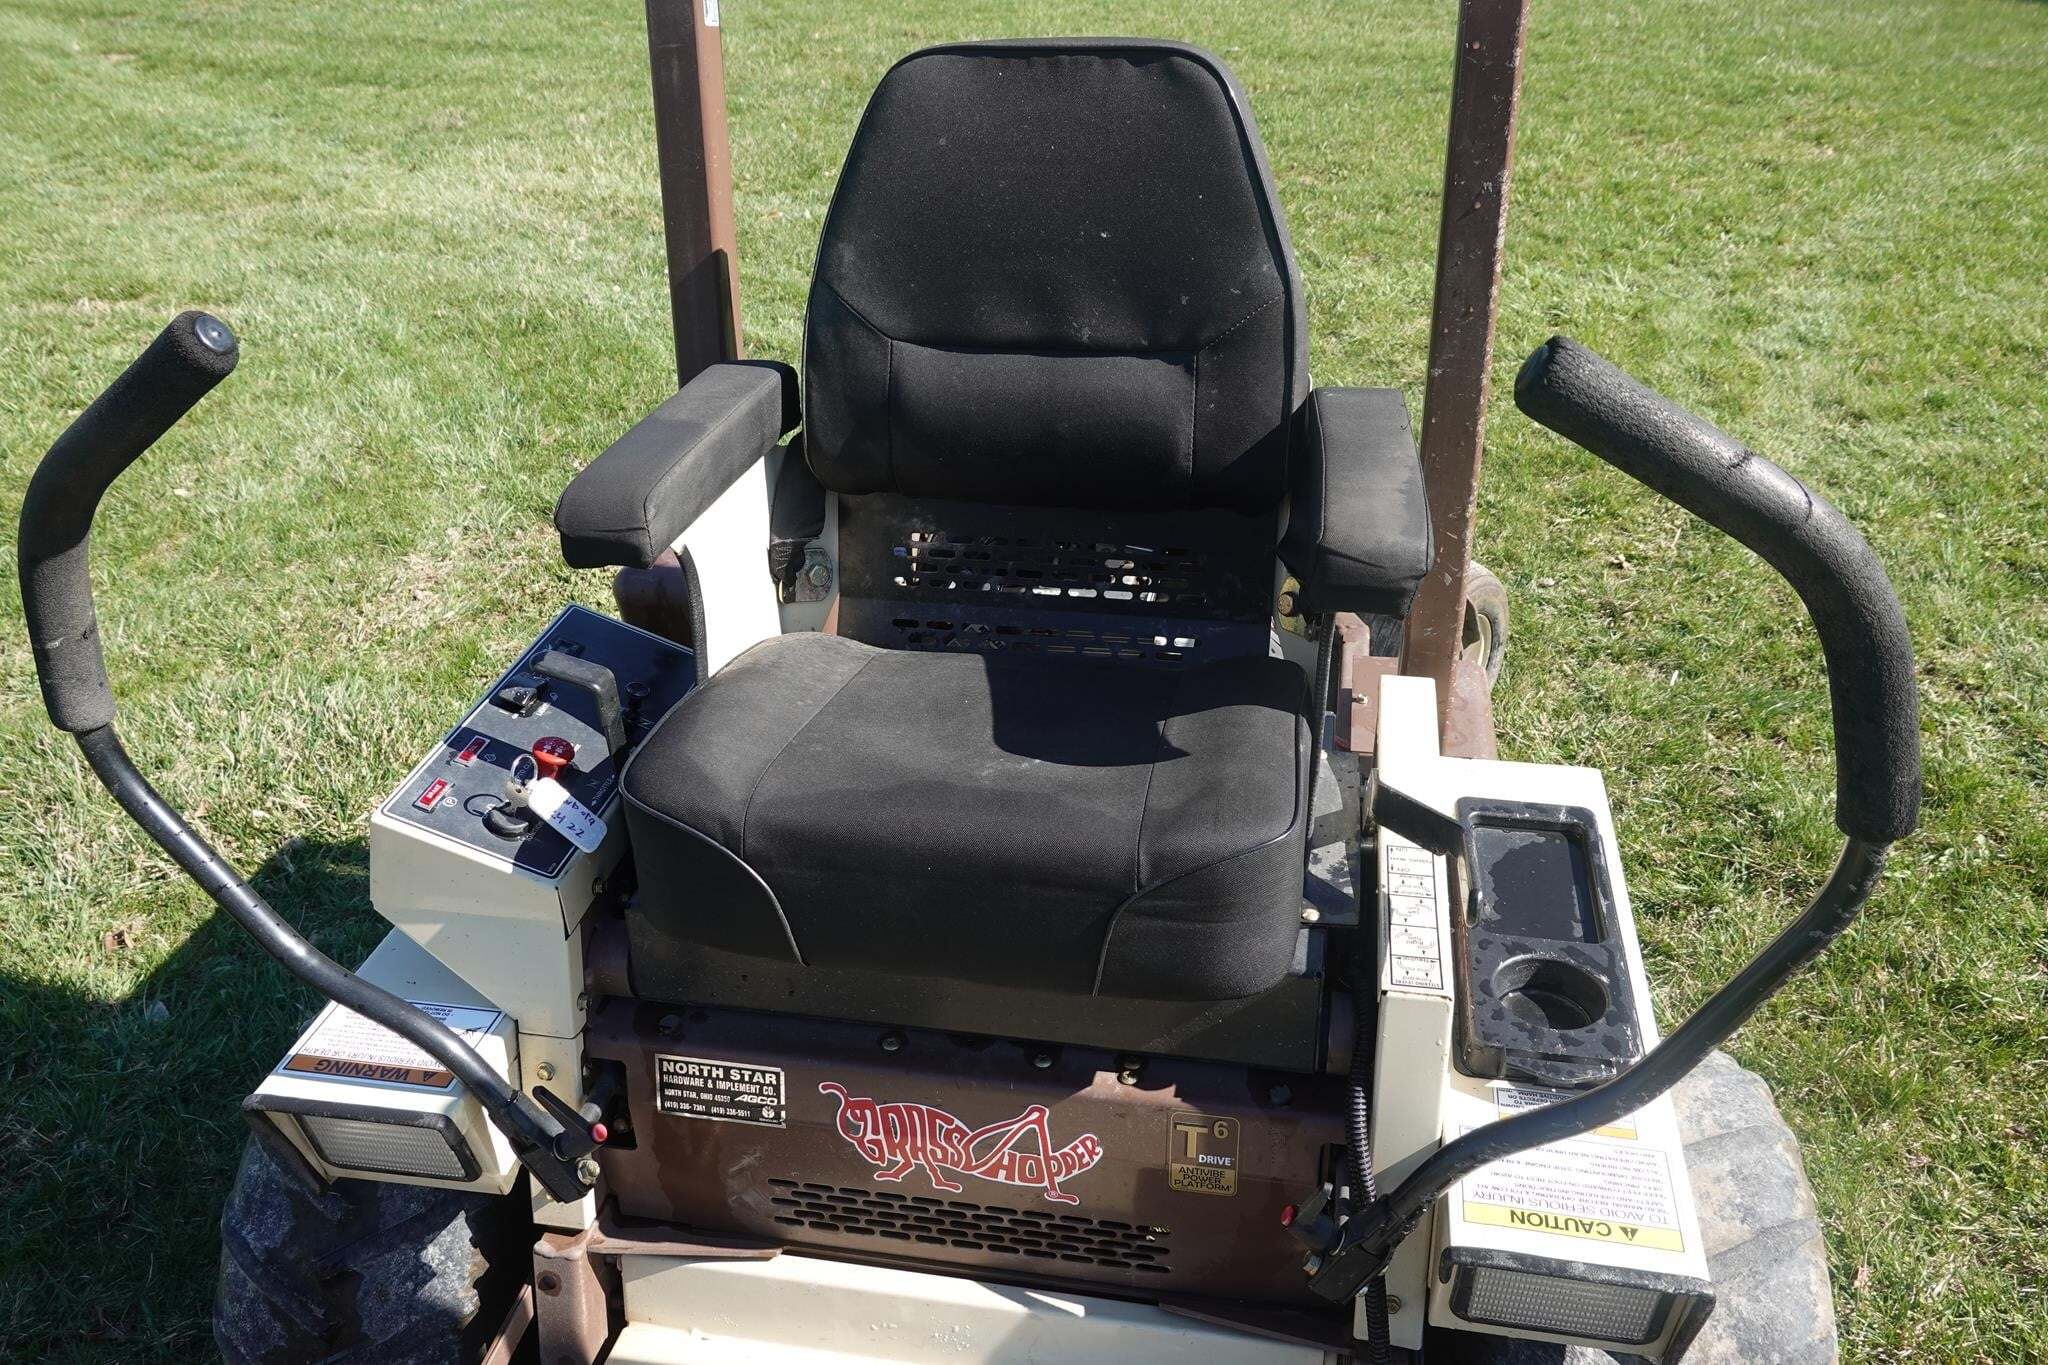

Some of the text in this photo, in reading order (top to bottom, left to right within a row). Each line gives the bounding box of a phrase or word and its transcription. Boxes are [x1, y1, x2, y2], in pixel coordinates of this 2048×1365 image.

[314, 1059, 410, 1081] WARNING
[663, 1061, 777, 1085] NORTH STAR
[663, 1074, 776, 1096] HARDWARE & IMPLEMENT CO.
[734, 1094, 778, 1106] AGCO
[1178, 1166, 1226, 1179] ANTIVIBE
[1183, 1173, 1222, 1185] POWER
[1174, 1179, 1232, 1192] PLATFORM
[1472, 1190, 1667, 1225] TO AVOID SERIOUS INJURY
[1509, 1208, 1612, 1237] CAUTION
